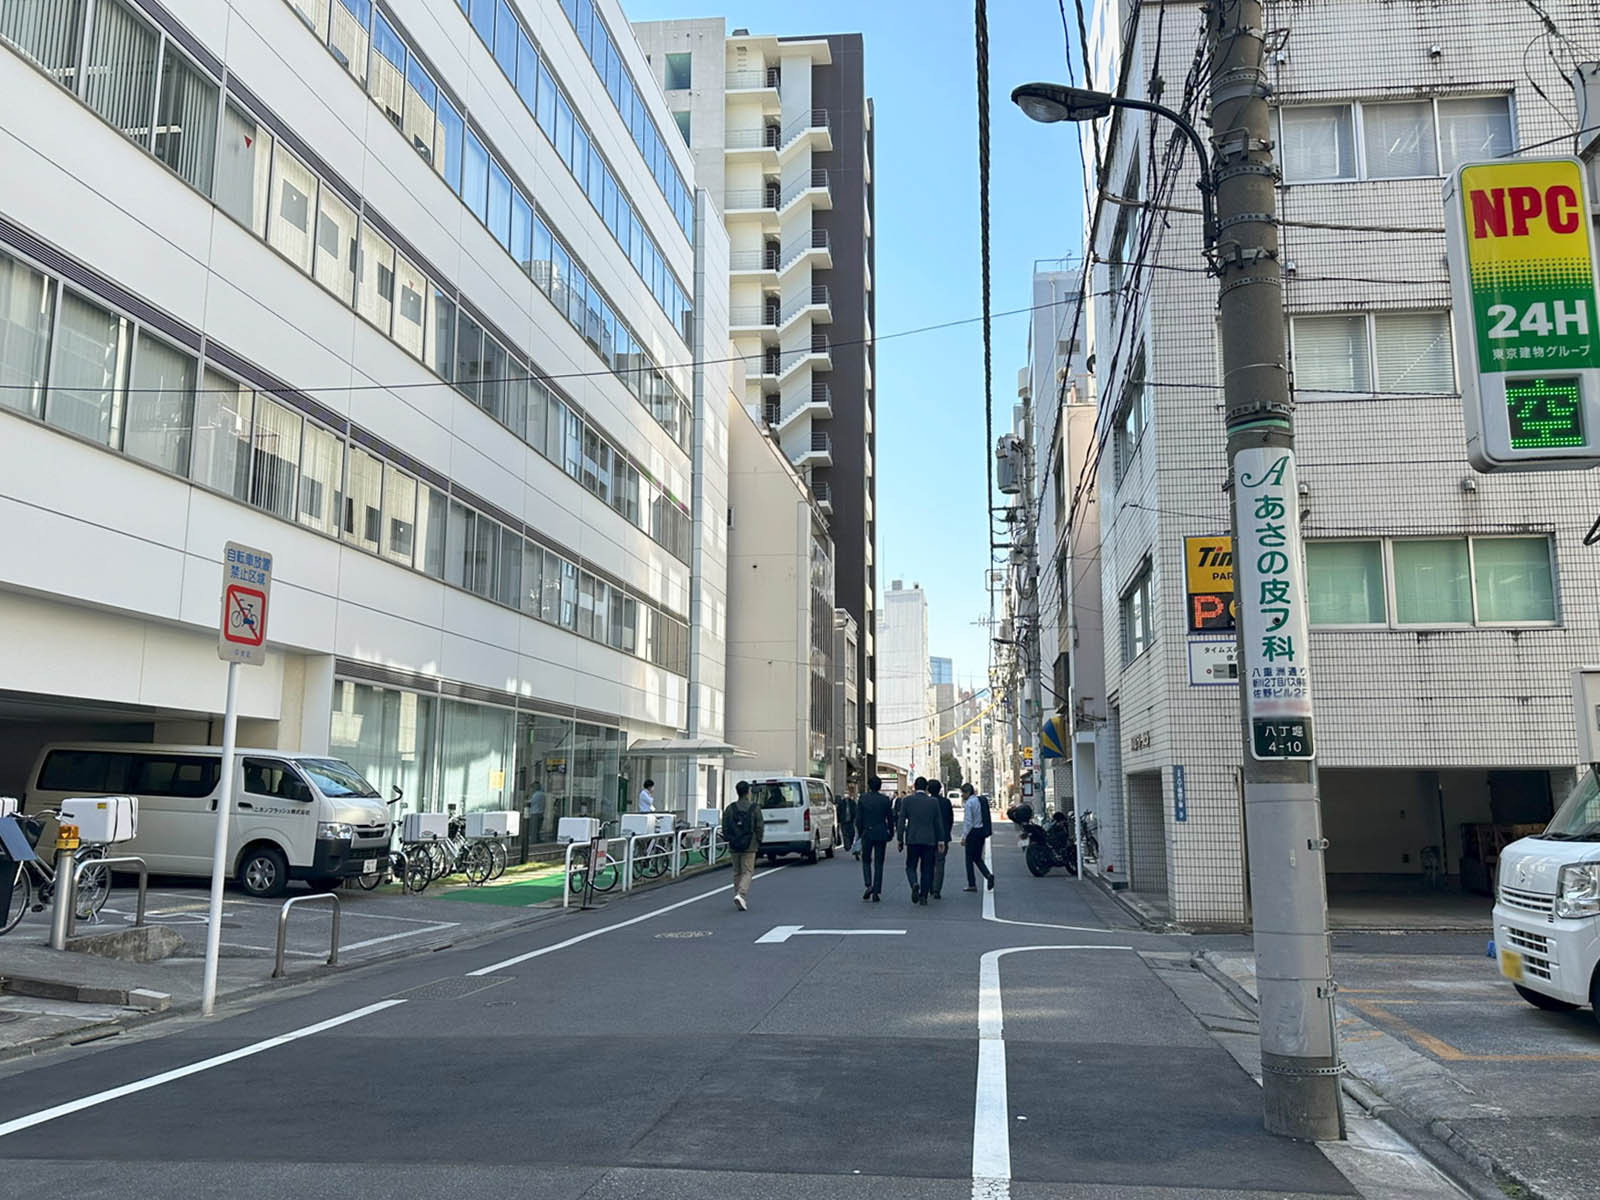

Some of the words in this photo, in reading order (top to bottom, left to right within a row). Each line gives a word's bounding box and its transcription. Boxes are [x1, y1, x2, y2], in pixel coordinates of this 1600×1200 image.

[1470, 185, 1580, 239] NPC
[1487, 300, 1590, 339] 24H
[1492, 344, 1591, 361] 東京建物グループ
[1505, 378, 1583, 449] 空
[1253, 494, 1295, 663] あさの皮フ科
[1193, 595, 1224, 628] P
[1264, 725, 1304, 737] 八丁堀
[1268, 741, 1302, 752] 4-10
